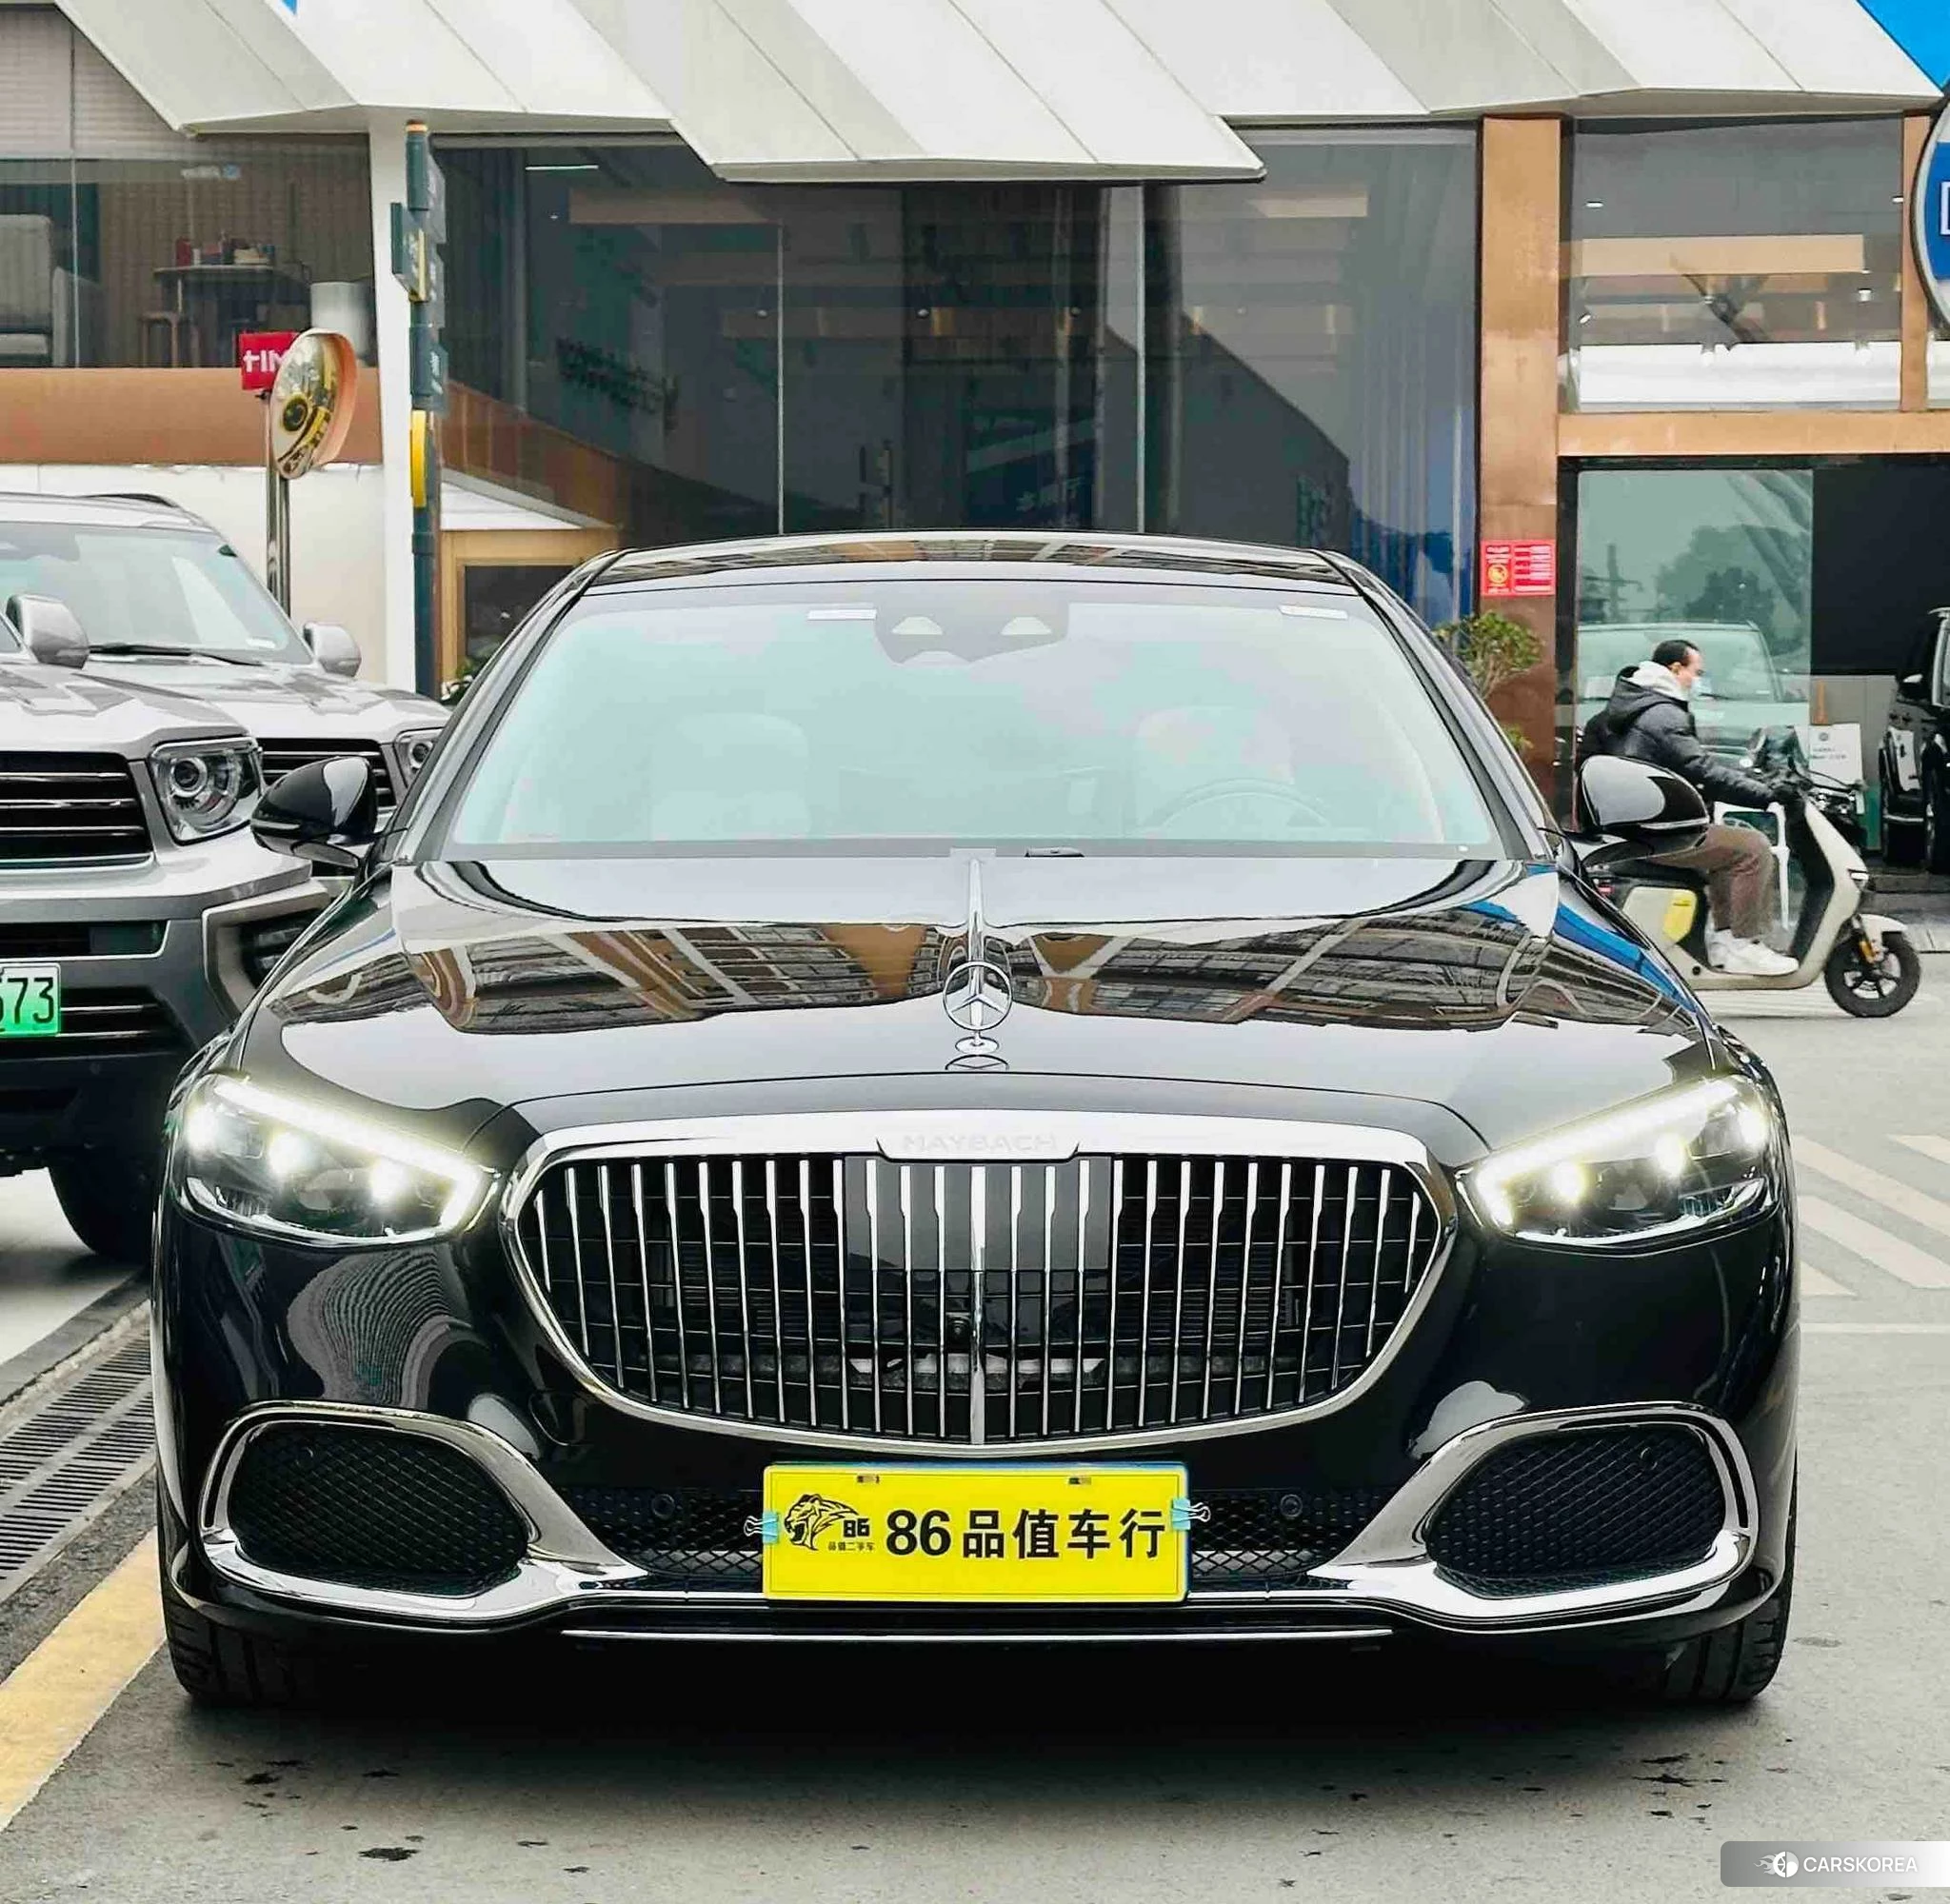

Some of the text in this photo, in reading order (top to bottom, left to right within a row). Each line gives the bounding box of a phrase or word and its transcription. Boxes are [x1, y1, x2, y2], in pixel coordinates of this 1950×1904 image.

[0, 978, 54, 1024] 73
[903, 1134, 1058, 1152] MAYBACH
[843, 1517, 870, 1537] 86
